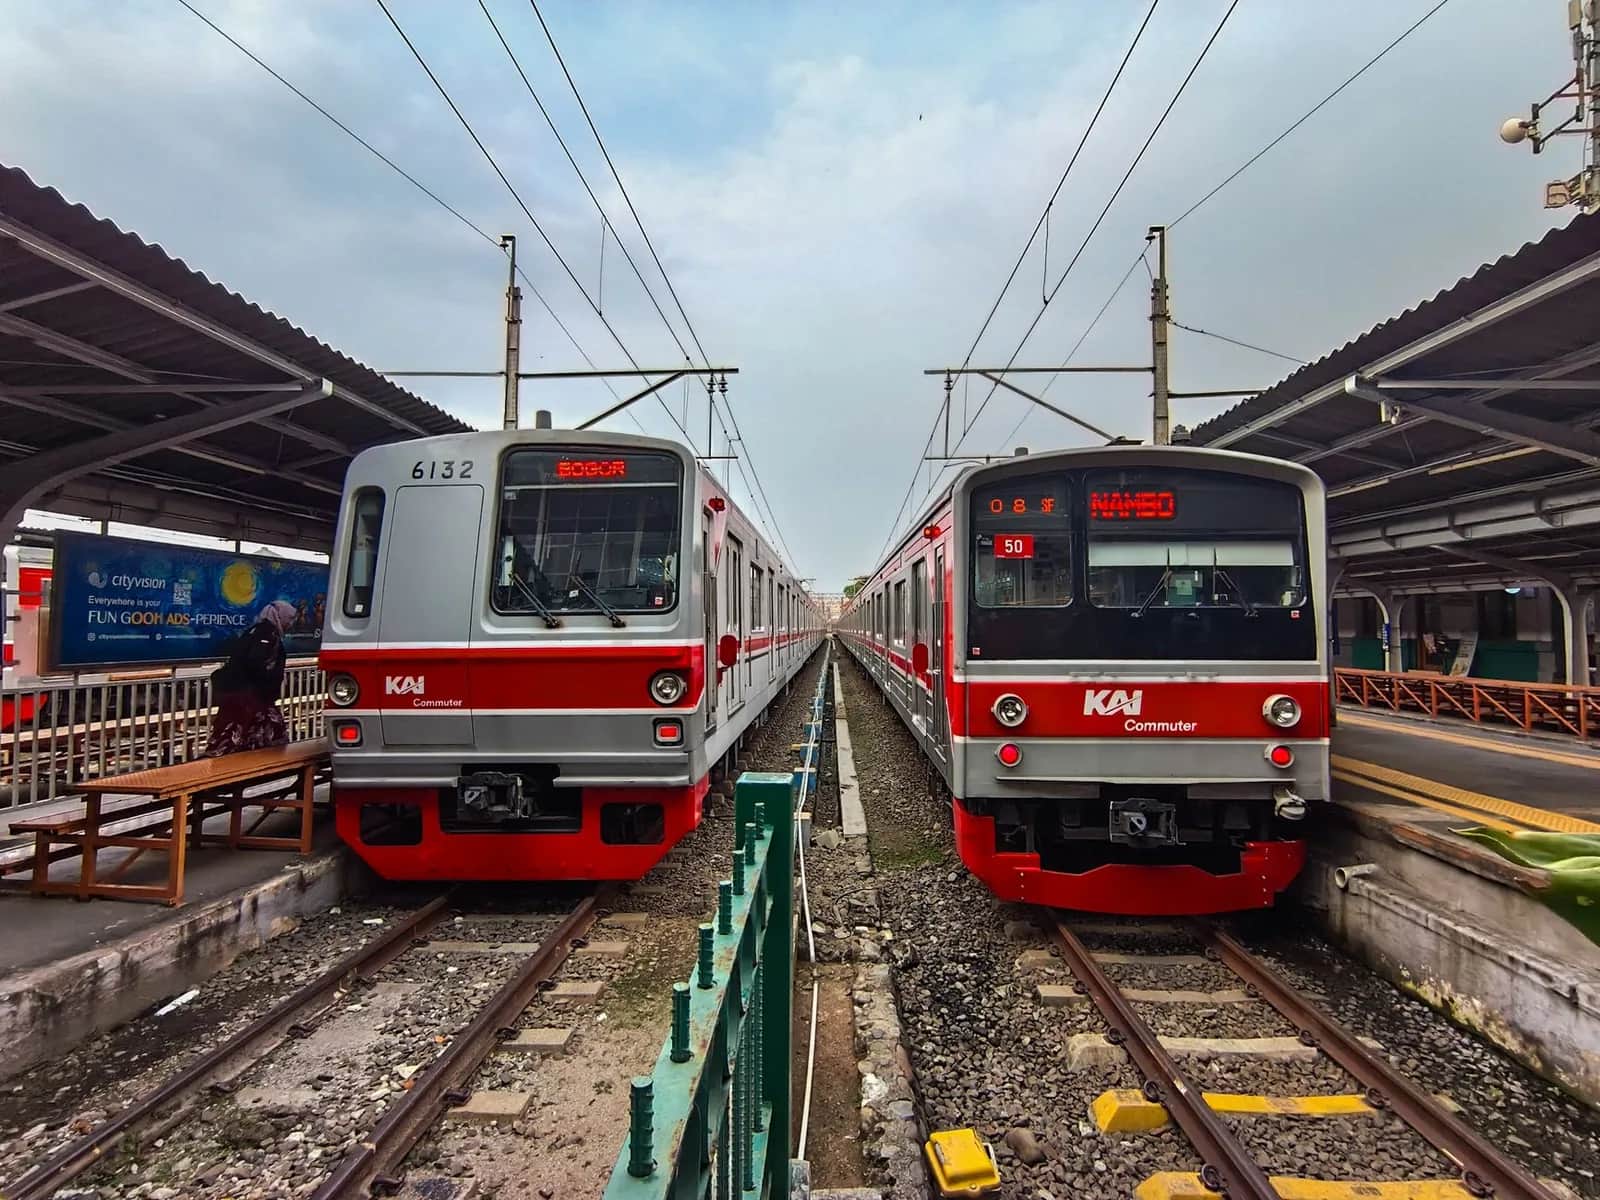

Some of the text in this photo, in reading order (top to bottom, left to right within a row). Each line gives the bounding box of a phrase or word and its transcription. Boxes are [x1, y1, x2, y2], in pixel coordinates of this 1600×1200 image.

[412, 460, 474, 479] 6132
[1004, 539, 1023, 554] 50
[112, 575, 166, 591] cityvision
[88, 595, 161, 608] Everywhere is your
[88, 610, 117, 624] FUN
[385, 675, 425, 695] KAI
[413, 698, 463, 708] Commuter
[1083, 689, 1143, 716] KAI
[1124, 719, 1198, 732] Commuter
